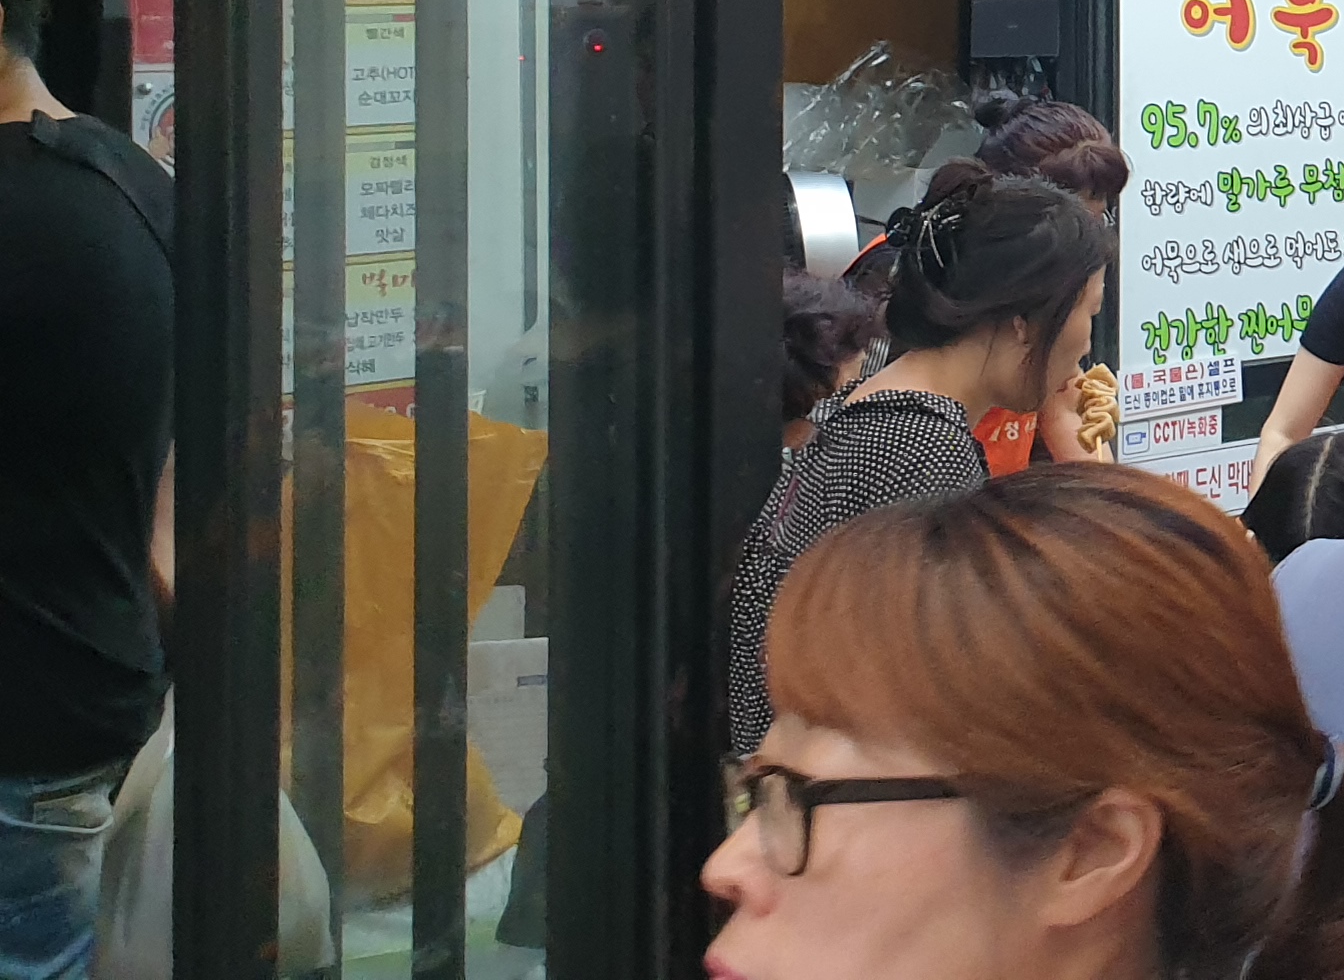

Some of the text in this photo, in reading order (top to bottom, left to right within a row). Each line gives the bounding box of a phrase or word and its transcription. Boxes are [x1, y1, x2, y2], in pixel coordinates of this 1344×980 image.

[1272, 99, 1334, 141] 최상급
[1141, 178, 1214, 215] 함량에
[1217, 161, 1297, 213] 밀가루
[1142, 231, 1340, 283] 어묵으로 생으로 먹어도
[1141, 301, 1235, 364] 건강한
[1207, 358, 1236, 378] 셀프
